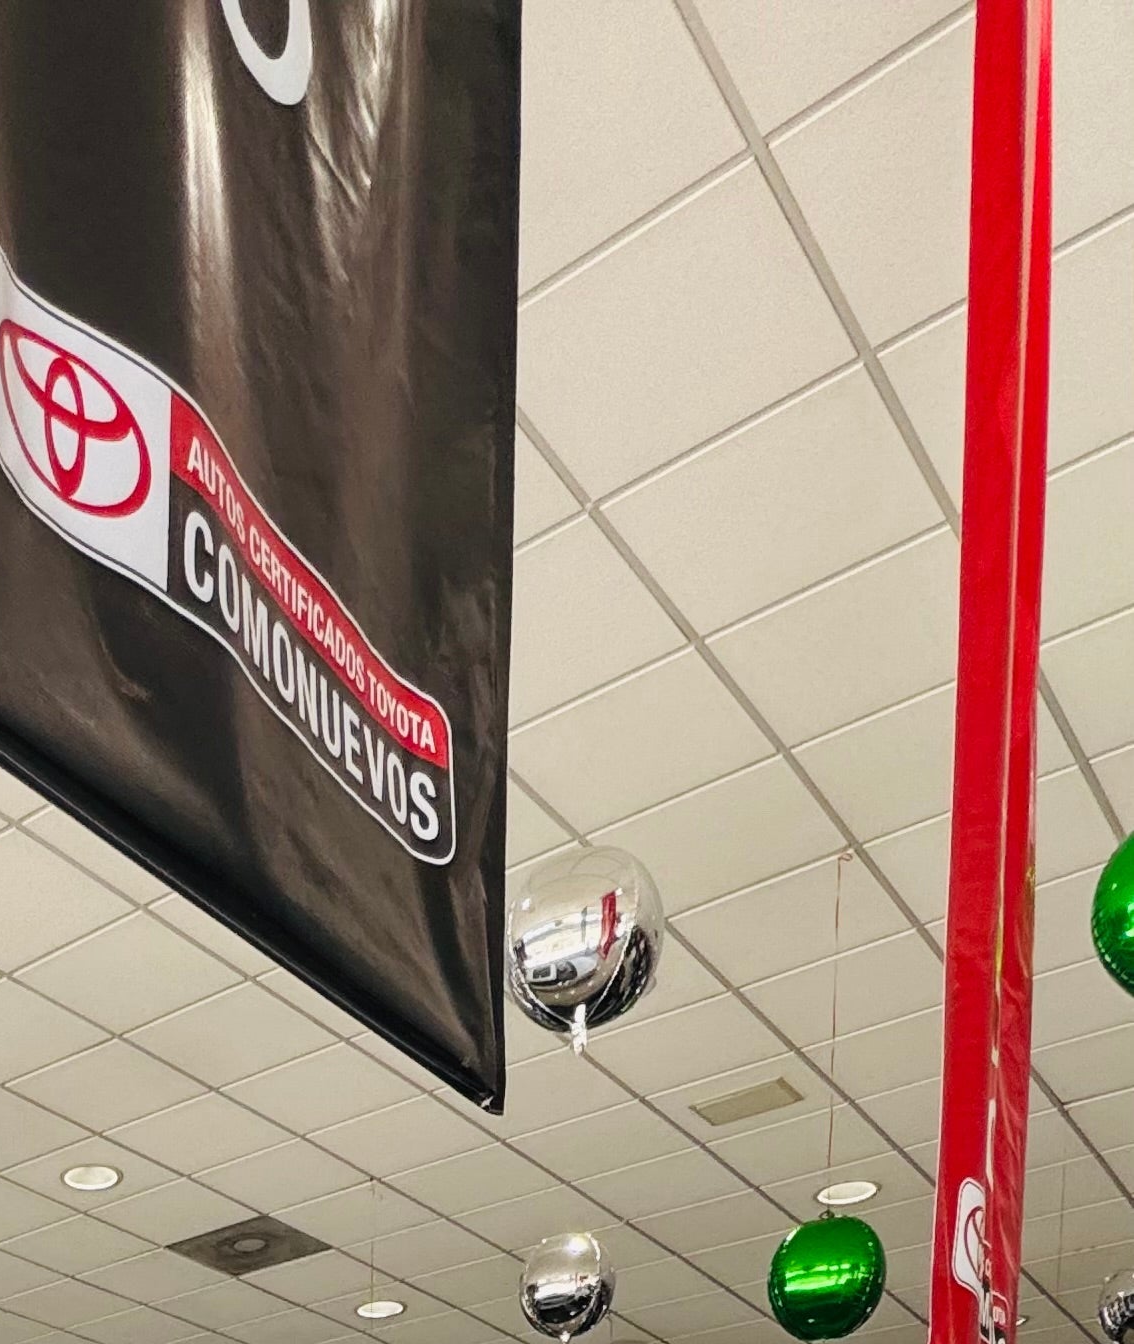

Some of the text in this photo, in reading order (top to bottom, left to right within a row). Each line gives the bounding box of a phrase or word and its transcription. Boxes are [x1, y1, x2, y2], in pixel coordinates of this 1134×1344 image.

[183, 510, 439, 842] COMONUEVOS
[187, 436, 437, 754] AUTOS CERTIFICADOS TOYOTA
